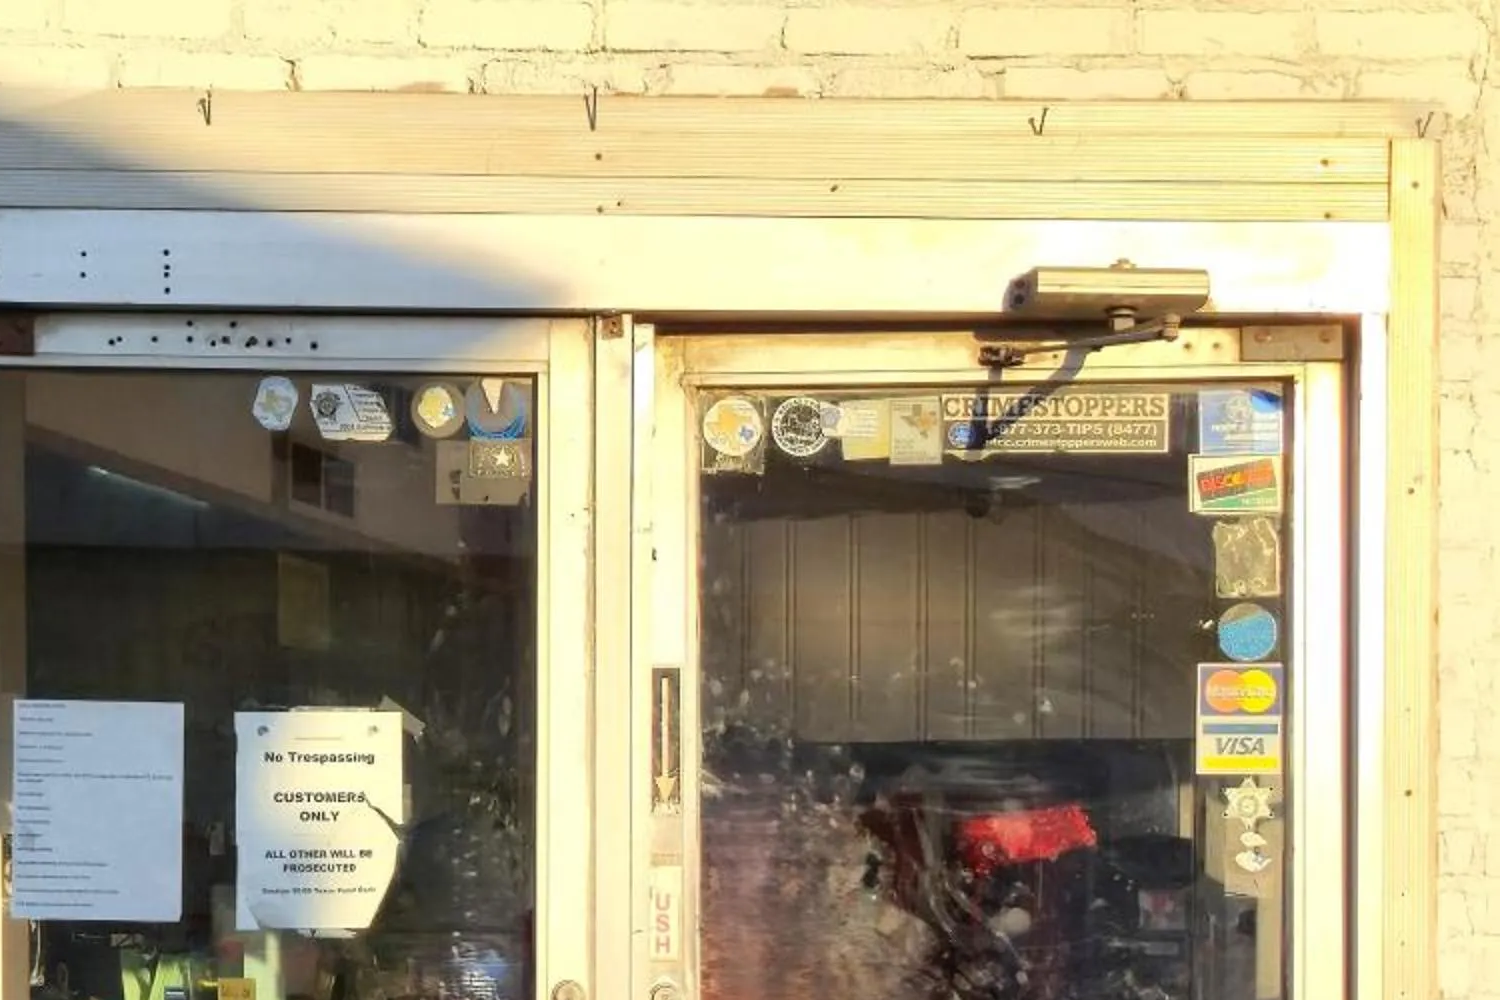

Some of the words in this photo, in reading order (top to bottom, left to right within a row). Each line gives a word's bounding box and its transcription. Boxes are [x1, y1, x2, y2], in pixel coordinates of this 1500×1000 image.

[943, 395, 1165, 418] CRIMESTOPPERS
[1106, 422, 1158, 437] (8477)
[1215, 736, 1266, 755] VISA
[264, 752, 283, 763] No
[287, 751, 375, 765] Trespassing
[273, 791, 366, 804] CUSTOMERS
[299, 810, 340, 822] ONLY
[265, 849, 287, 860] ALL
[289, 849, 327, 860] OTHER
[329, 849, 357, 860] WILL
[283, 863, 357, 874] PROSECUTED
